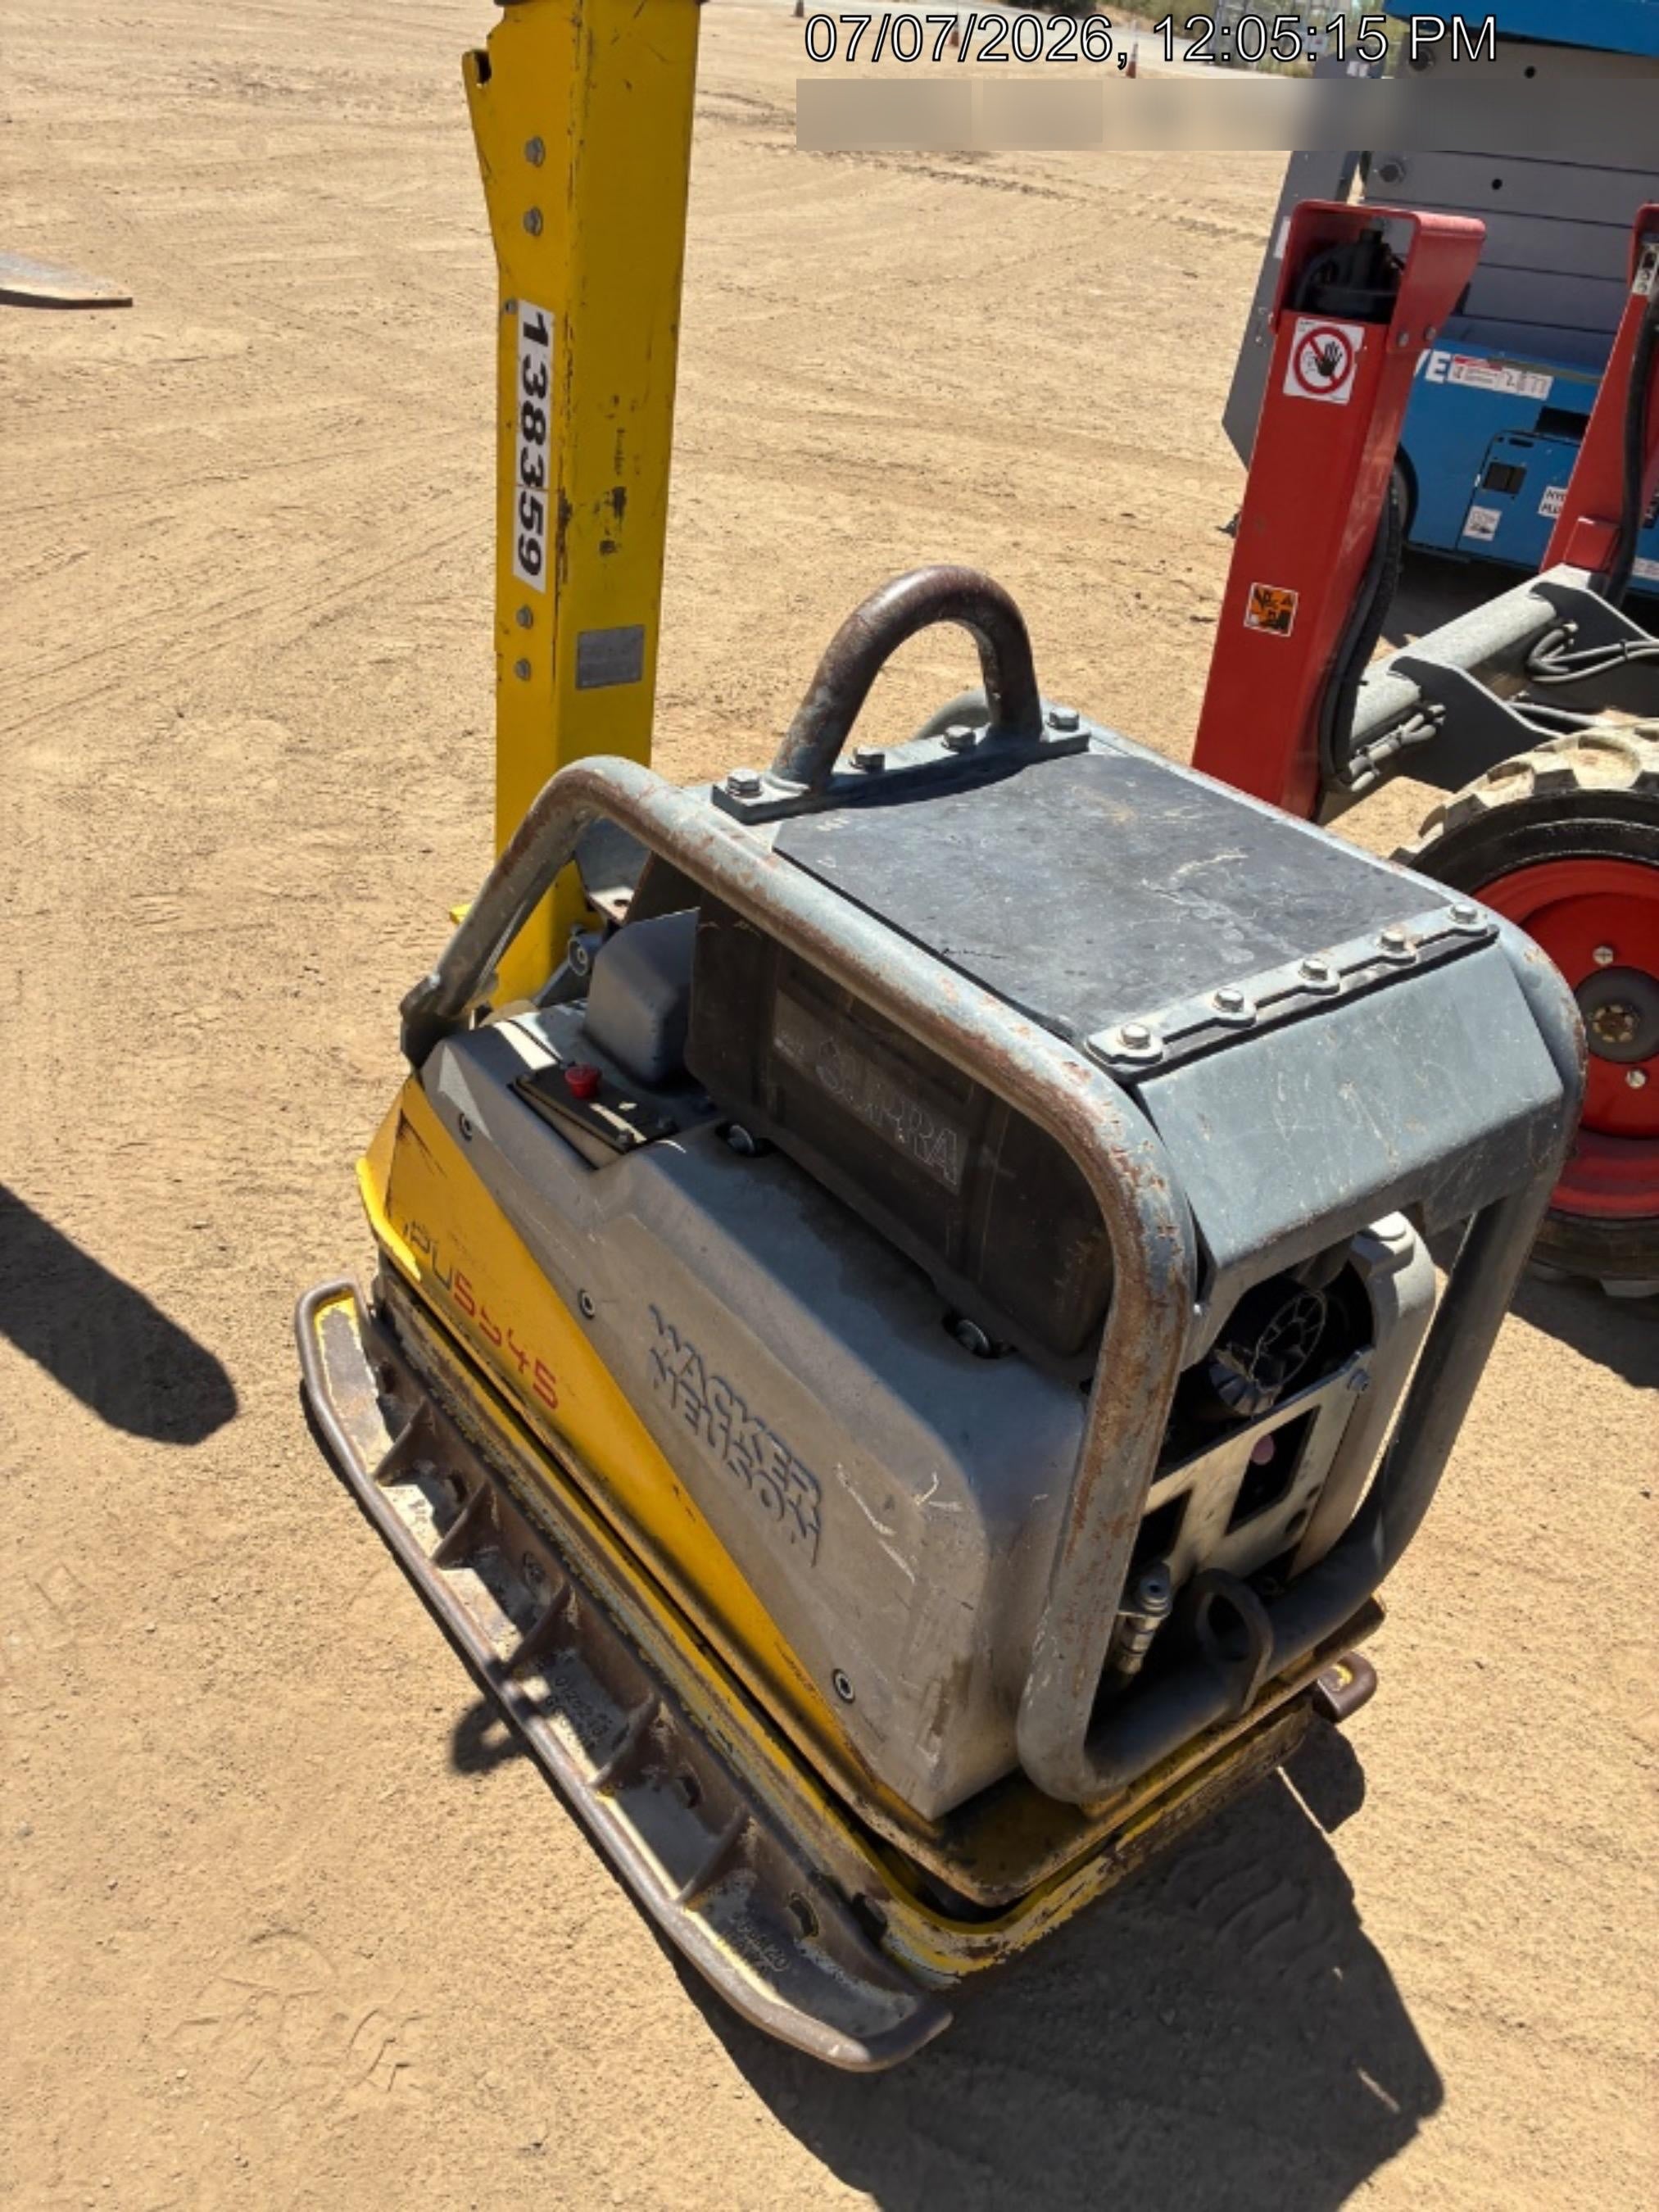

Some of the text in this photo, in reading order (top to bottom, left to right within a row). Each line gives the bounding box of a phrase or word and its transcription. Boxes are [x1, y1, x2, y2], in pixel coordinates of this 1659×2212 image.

[517, 310, 551, 577] 1383359
[403, 1220, 559, 1410] PU5545
[649, 1303, 823, 1512] WACKER
